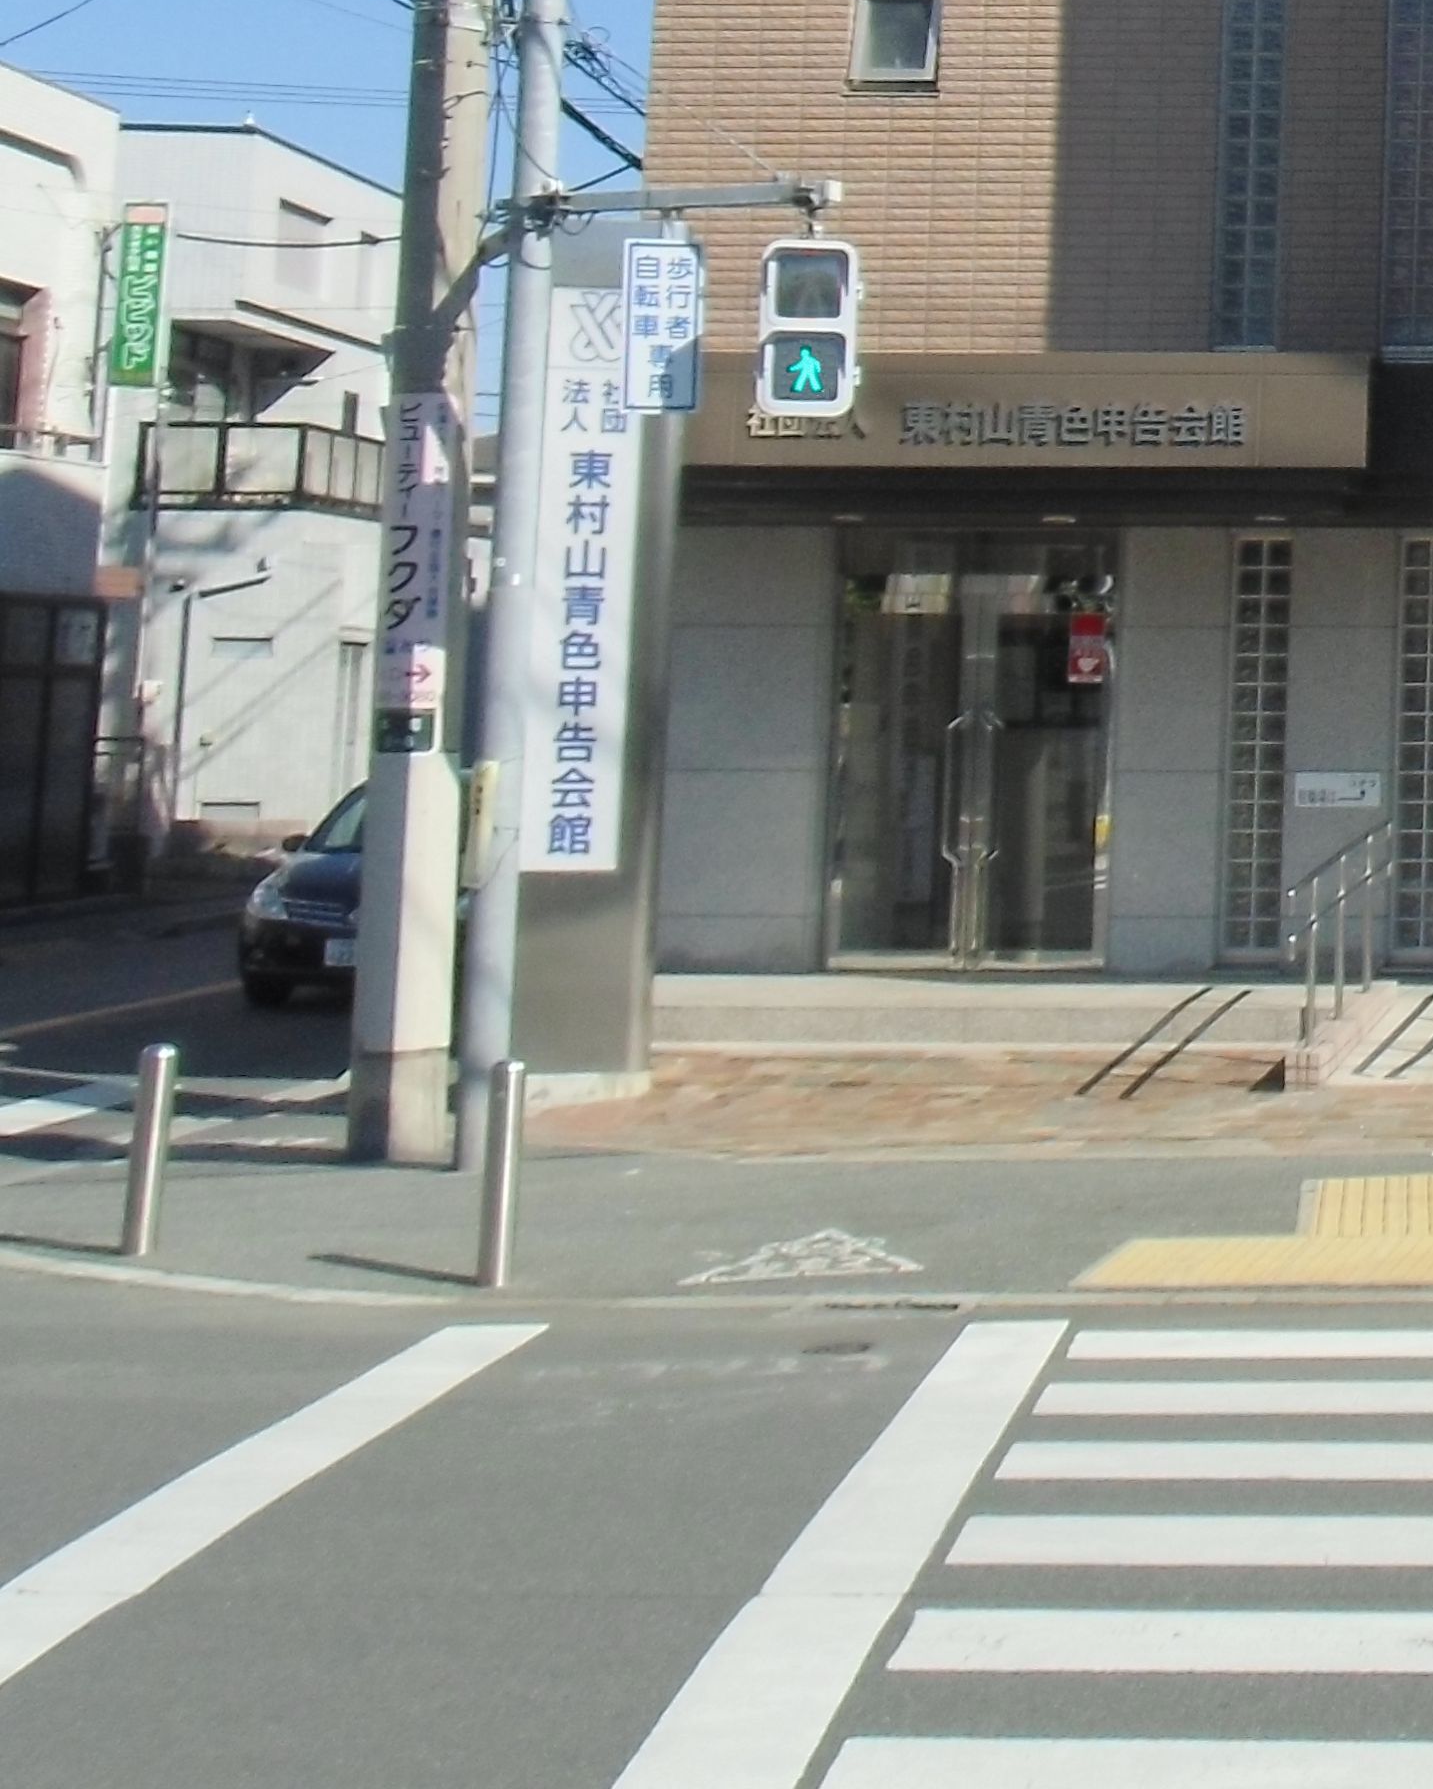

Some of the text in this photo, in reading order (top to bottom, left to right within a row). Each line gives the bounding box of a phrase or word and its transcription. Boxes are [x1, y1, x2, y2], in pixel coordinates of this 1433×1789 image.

[632, 255, 660, 339] 自転車
[665, 256, 694, 340] 歩行者
[648, 344, 674, 400] 専用
[560, 377, 591, 432] 法人
[600, 378, 627, 433] 社団
[899, 400, 1246, 447] 東村山青色申告会館
[547, 449, 614, 855] 東村山青色申告会館
